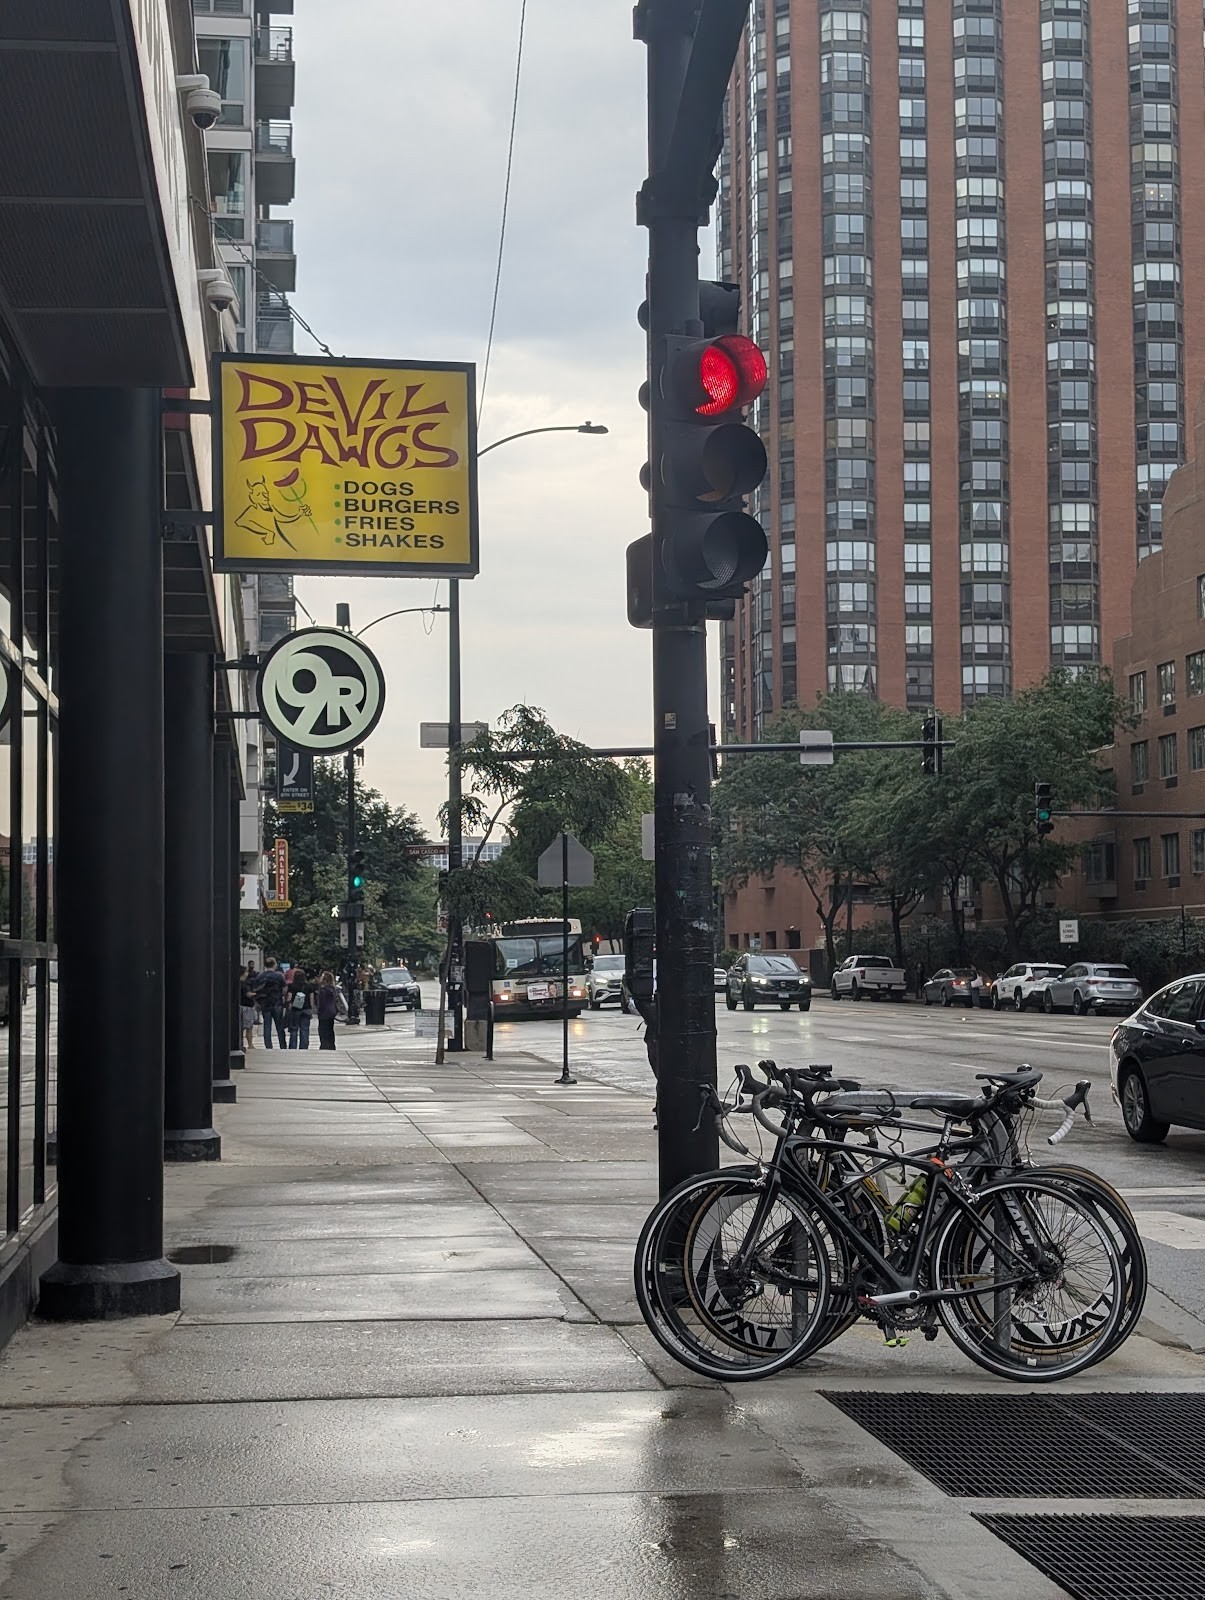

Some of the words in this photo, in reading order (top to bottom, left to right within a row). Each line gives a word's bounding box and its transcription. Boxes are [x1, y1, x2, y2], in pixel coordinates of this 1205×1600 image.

[234, 368, 450, 437] DEVIL
[239, 416, 459, 470] DAWGS
[344, 480, 414, 496] DOGS
[344, 498, 460, 515] BURGERS
[344, 516, 415, 531] FRIES
[345, 533, 445, 549] SHAKES
